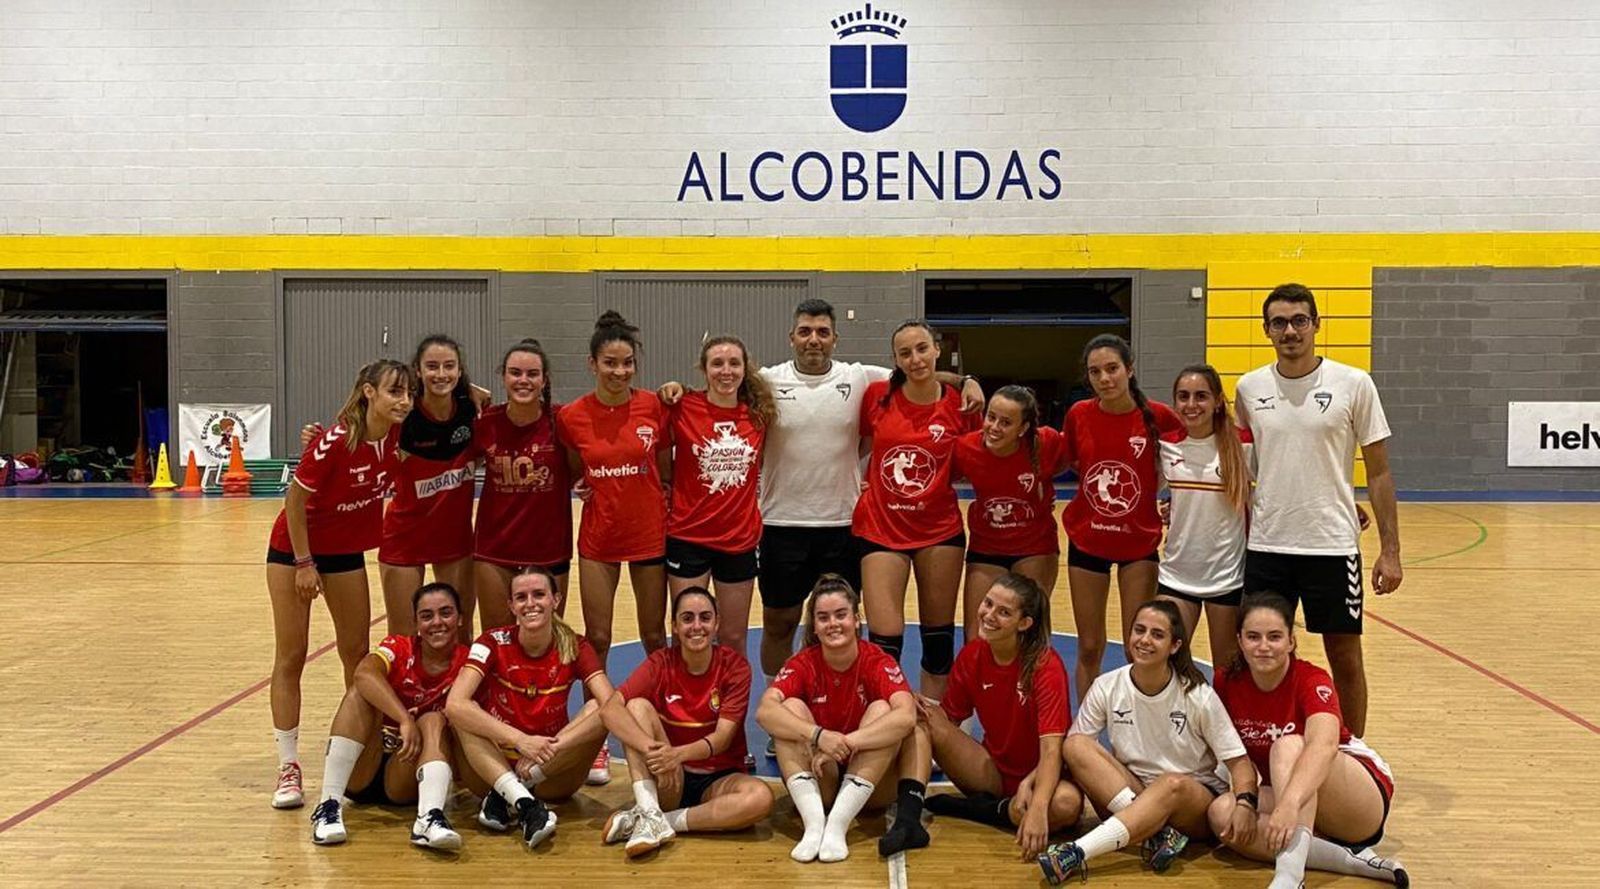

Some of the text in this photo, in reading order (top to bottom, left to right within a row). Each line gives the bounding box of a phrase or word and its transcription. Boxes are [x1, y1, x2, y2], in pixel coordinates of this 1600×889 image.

[677, 150, 1062, 202] ALCOBENDAS
[201, 412, 220, 440] Escuela
[588, 463, 639, 478] helvetia
